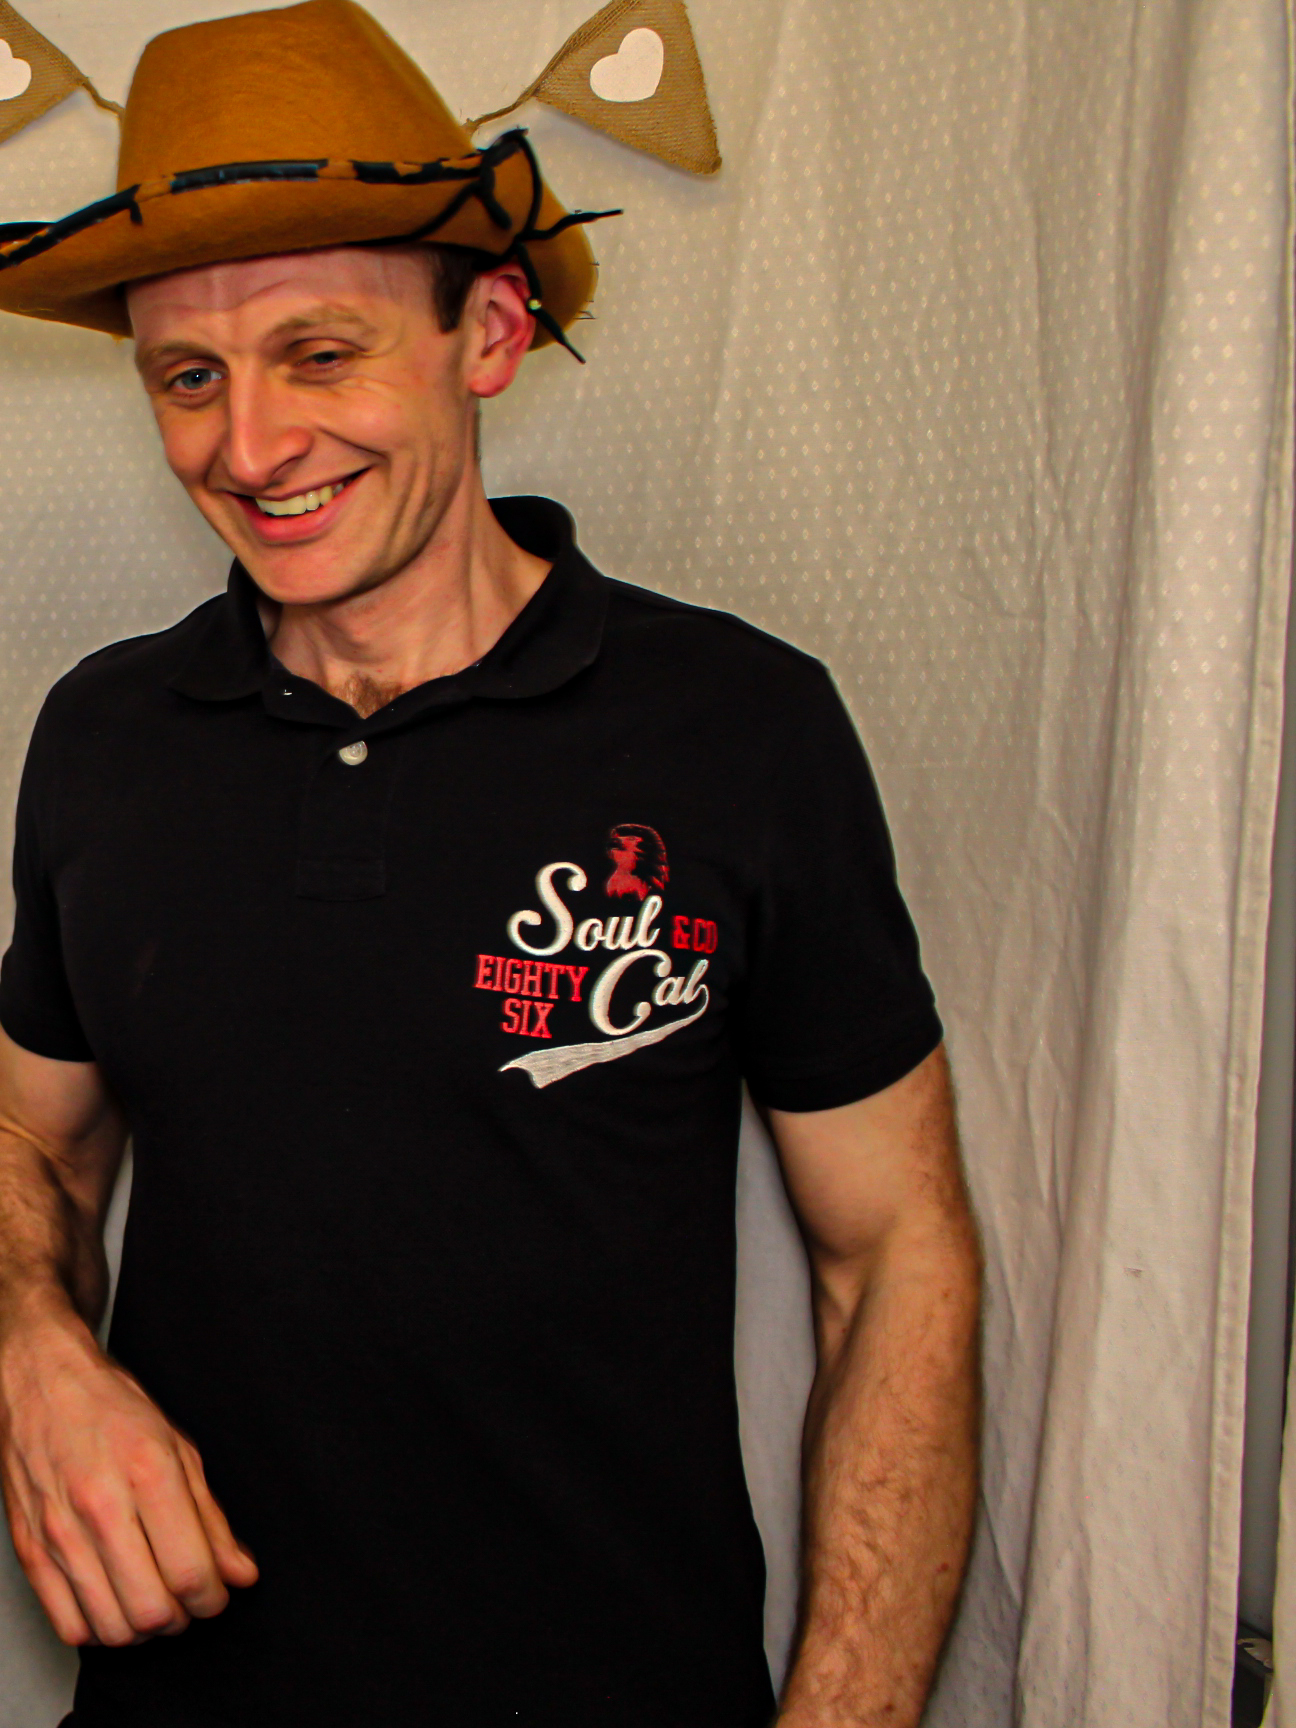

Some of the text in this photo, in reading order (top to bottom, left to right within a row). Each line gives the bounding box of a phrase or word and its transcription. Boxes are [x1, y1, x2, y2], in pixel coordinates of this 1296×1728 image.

[507, 861, 663, 956] Soul
[474, 954, 589, 1002] EIGHTY
[588, 949, 709, 1036] Cal
[501, 998, 554, 1039] SIX
